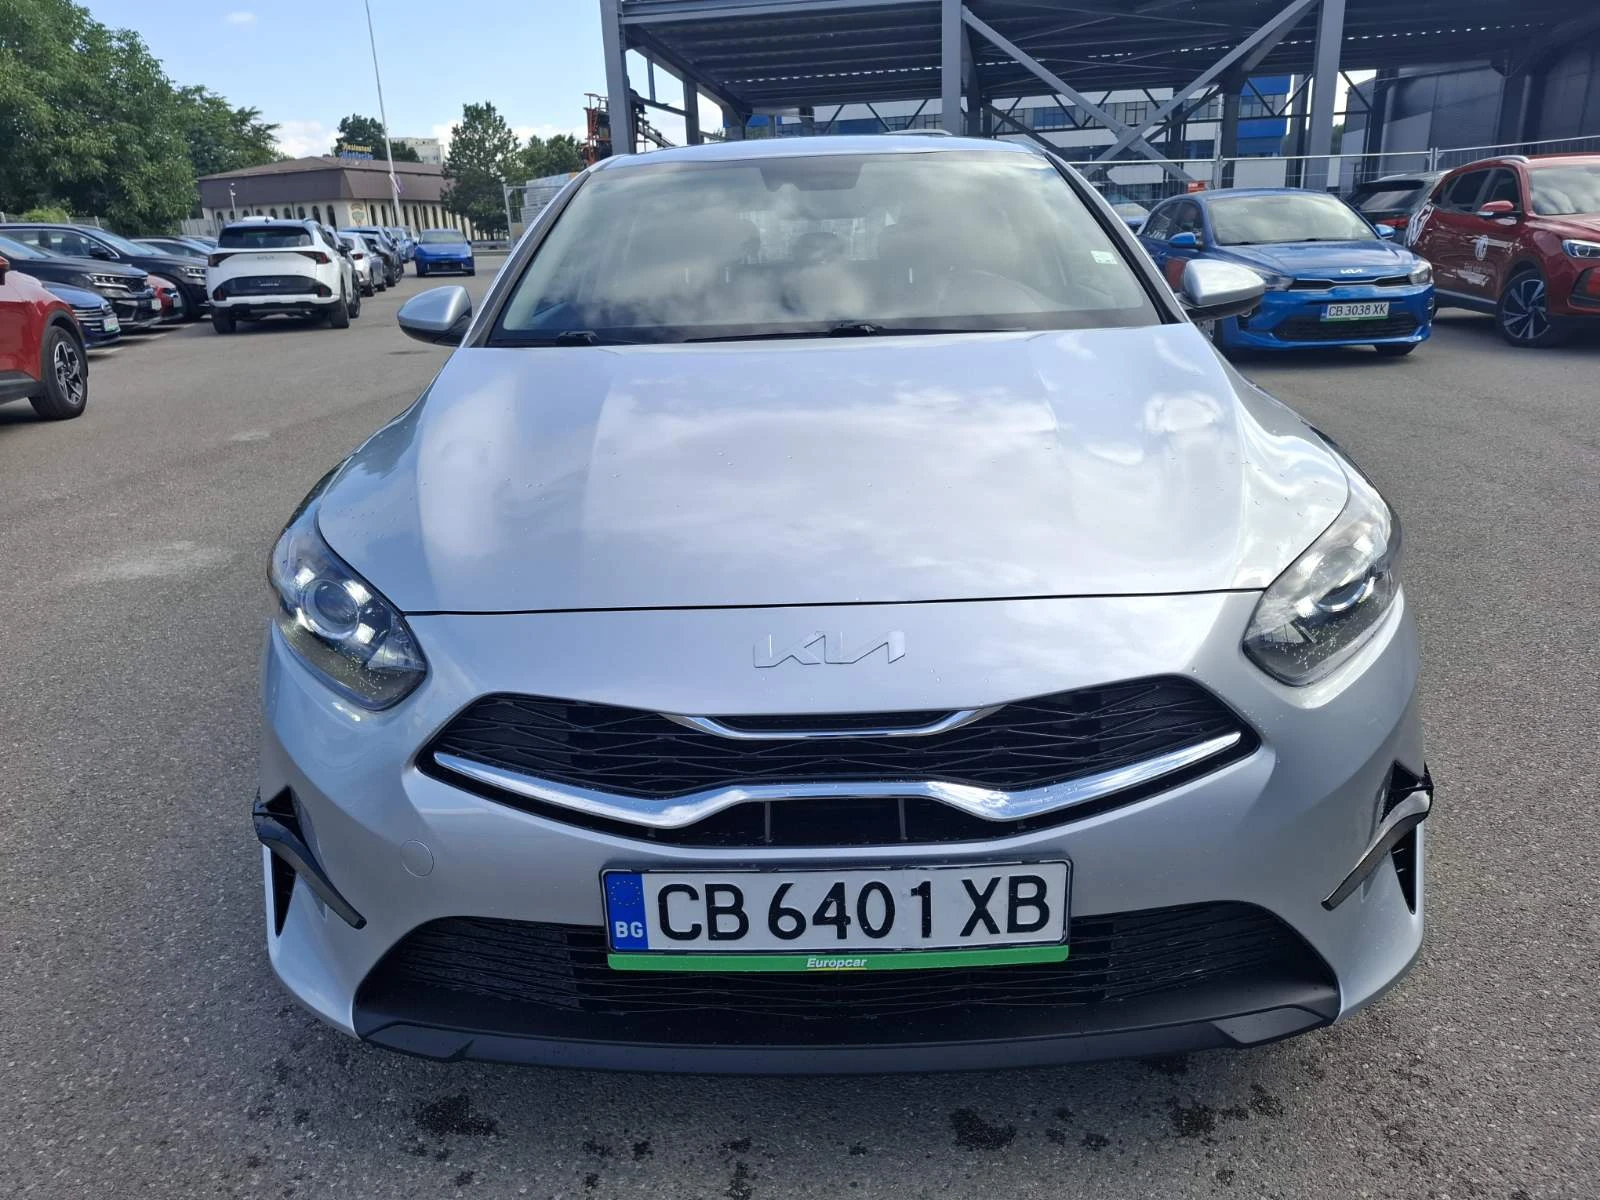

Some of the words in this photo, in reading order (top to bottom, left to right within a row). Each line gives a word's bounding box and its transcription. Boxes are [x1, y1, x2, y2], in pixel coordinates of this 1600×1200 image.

[1328, 306, 1343, 316] CB
[1344, 304, 1371, 316] 3038
[1372, 303, 1387, 314] XK
[753, 630, 906, 668] KIA
[657, 882, 749, 941] CB
[767, 880, 932, 940] 6401
[959, 875, 1050, 937] XB
[615, 921, 643, 938] BG
[806, 957, 868, 971] Europcar
